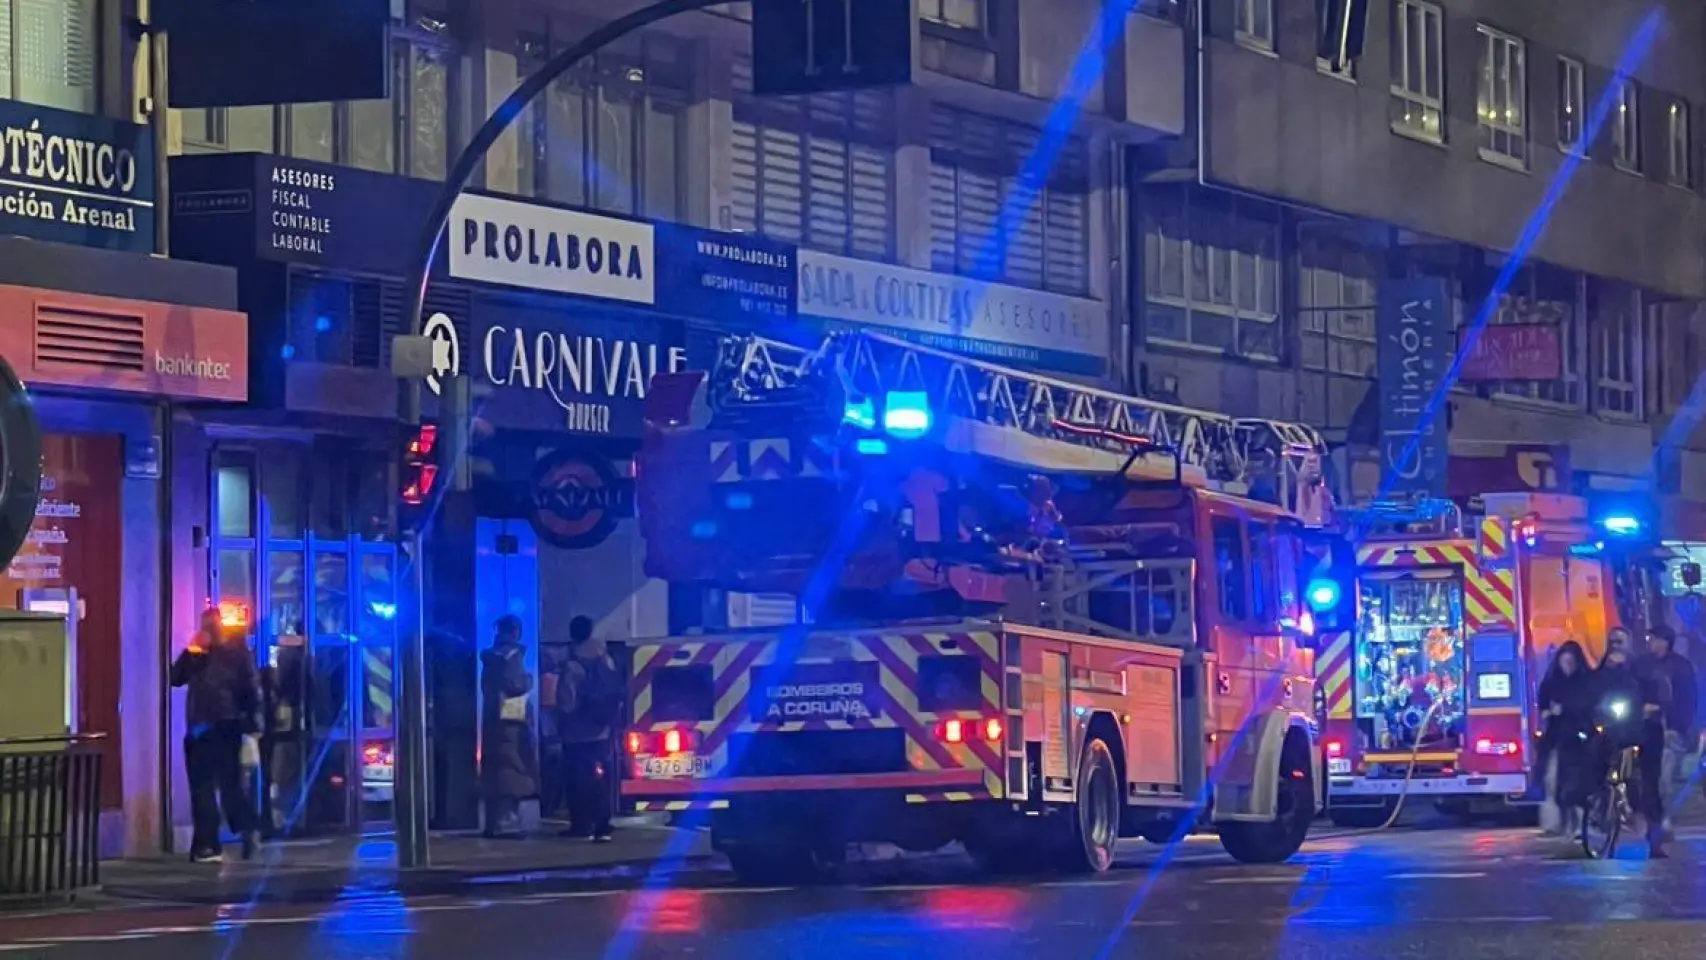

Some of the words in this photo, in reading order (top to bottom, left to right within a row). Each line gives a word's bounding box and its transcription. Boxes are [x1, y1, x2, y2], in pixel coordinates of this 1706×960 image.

[0, 118, 135, 192] TÉCNICO
[271, 167, 335, 191] ASESORES
[0, 191, 55, 219] ción
[62, 198, 135, 231] Arenal
[271, 190, 312, 209] FISCAL
[272, 211, 331, 233] CONTABLE
[272, 232, 323, 253] LABORAL
[464, 218, 643, 280] PROLABORA
[801, 261, 858, 310] SADA
[874, 274, 973, 329] CORTIZAS
[982, 299, 1094, 341] ASESORES
[767, 704, 781, 716] A
